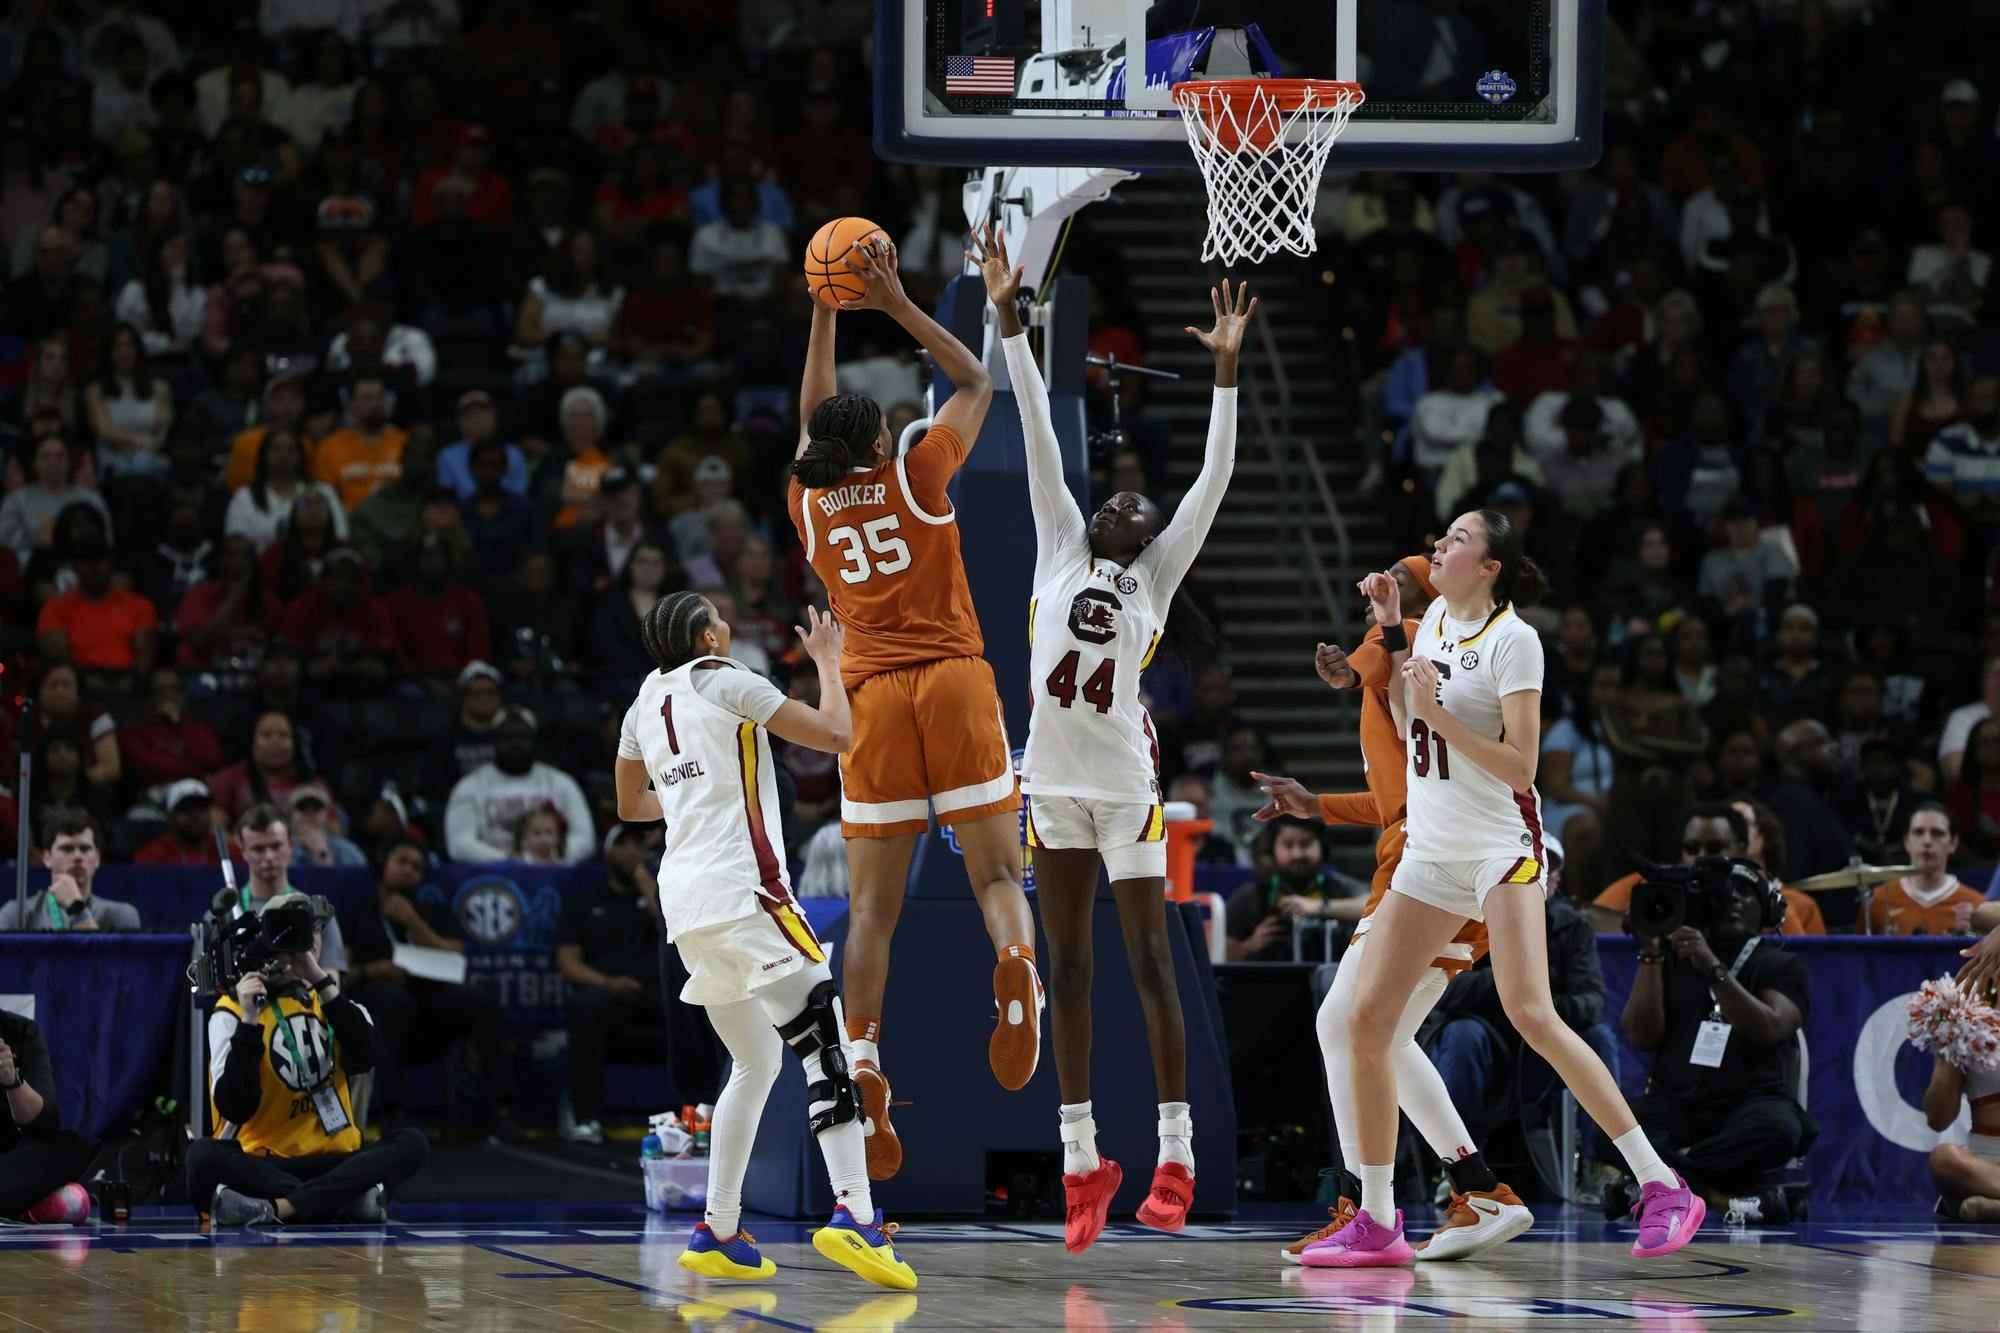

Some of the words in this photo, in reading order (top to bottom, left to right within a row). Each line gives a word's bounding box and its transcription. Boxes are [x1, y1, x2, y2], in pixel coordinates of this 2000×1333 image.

[817, 484, 886, 518] BOOKER
[827, 513, 913, 585] 35
[1118, 578, 1136, 593] SEC
[1046, 649, 1116, 714] 44
[1461, 651, 1478, 669] SEC
[660, 694, 681, 756] 1
[1411, 718, 1450, 780] 31
[465, 889, 516, 940] SEC
[271, 1013, 332, 1090] SEC
